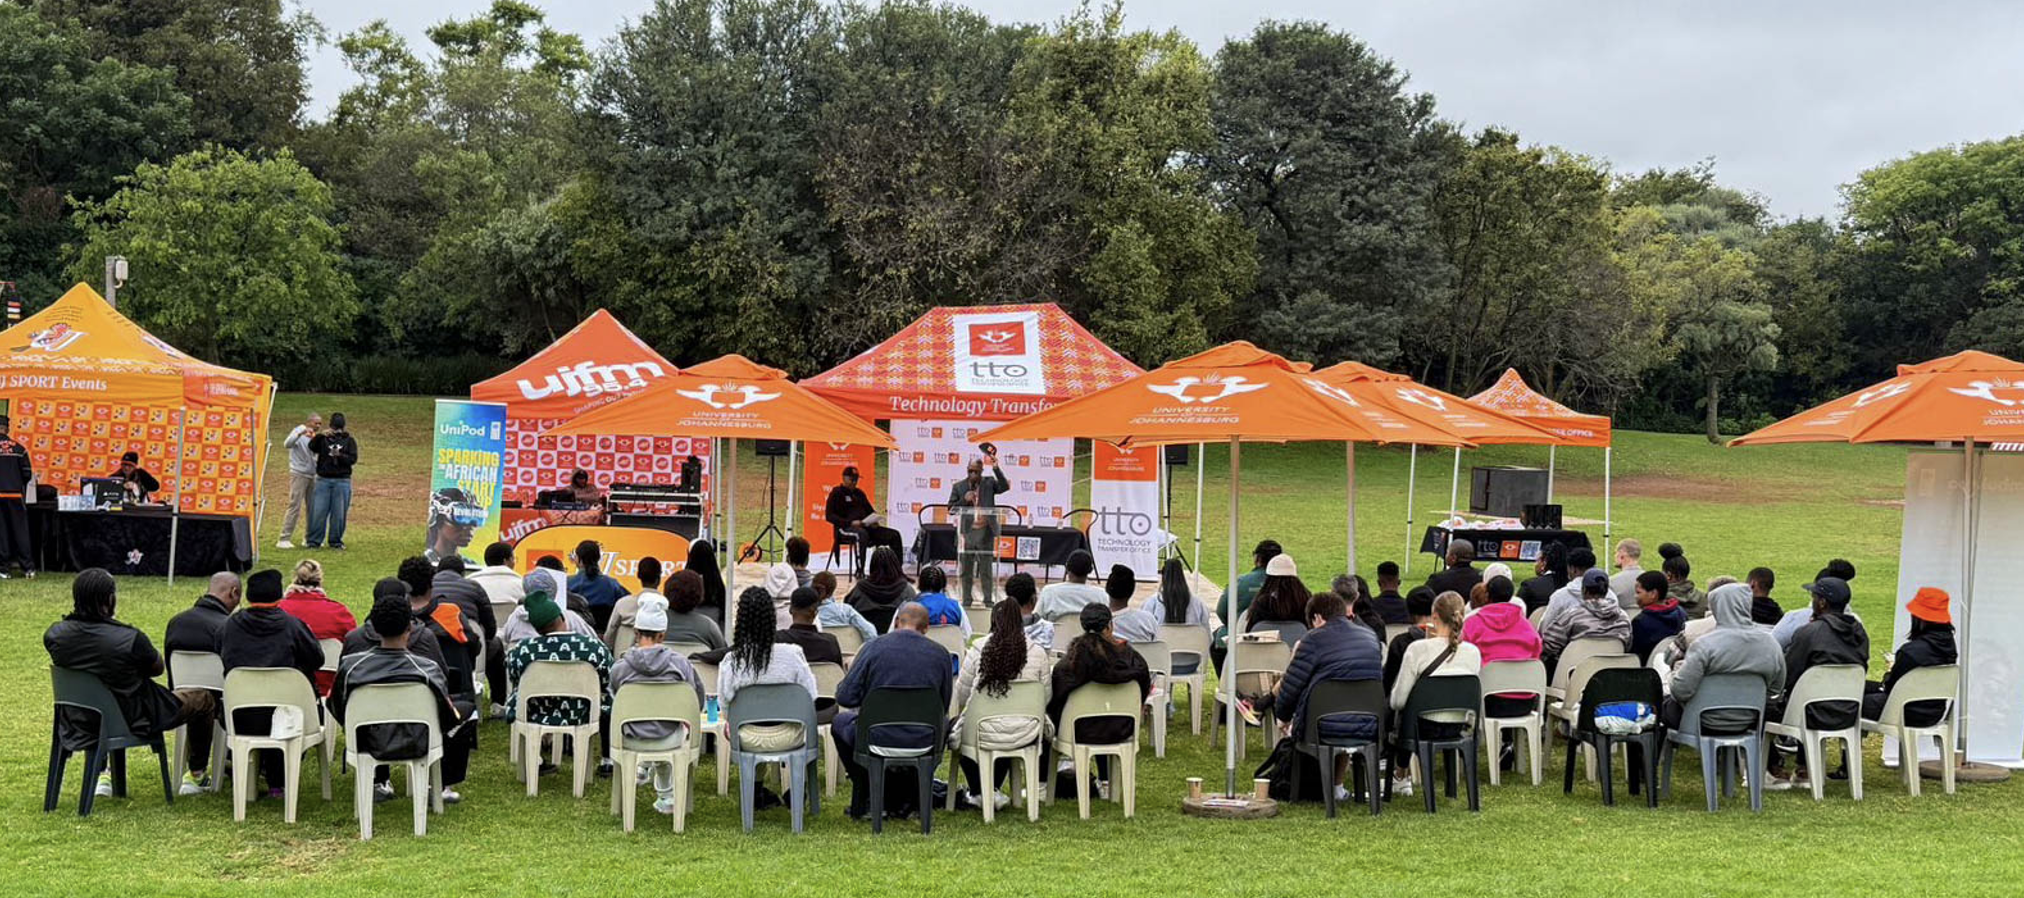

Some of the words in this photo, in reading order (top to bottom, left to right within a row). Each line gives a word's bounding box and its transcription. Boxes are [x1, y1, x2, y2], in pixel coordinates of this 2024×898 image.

[969, 361, 1027, 378] tto
[9, 375, 59, 389] SPORT
[61, 377, 107, 391] Events
[517, 360, 664, 400] ujfm
[889, 396, 986, 416] Technology
[990, 397, 1057, 414] Transfe
[692, 411, 760, 419] UNIVERSITY
[440, 420, 486, 437] UniPod
[676, 419, 771, 429] JOHANNESBURG
[438, 448, 500, 467] SPARKING
[445, 464, 498, 484] AFRICAN
[1098, 506, 1152, 536] tto
[1098, 538, 1151, 546] TECHNOLOGY
[615, 559, 690, 577] SPRT
